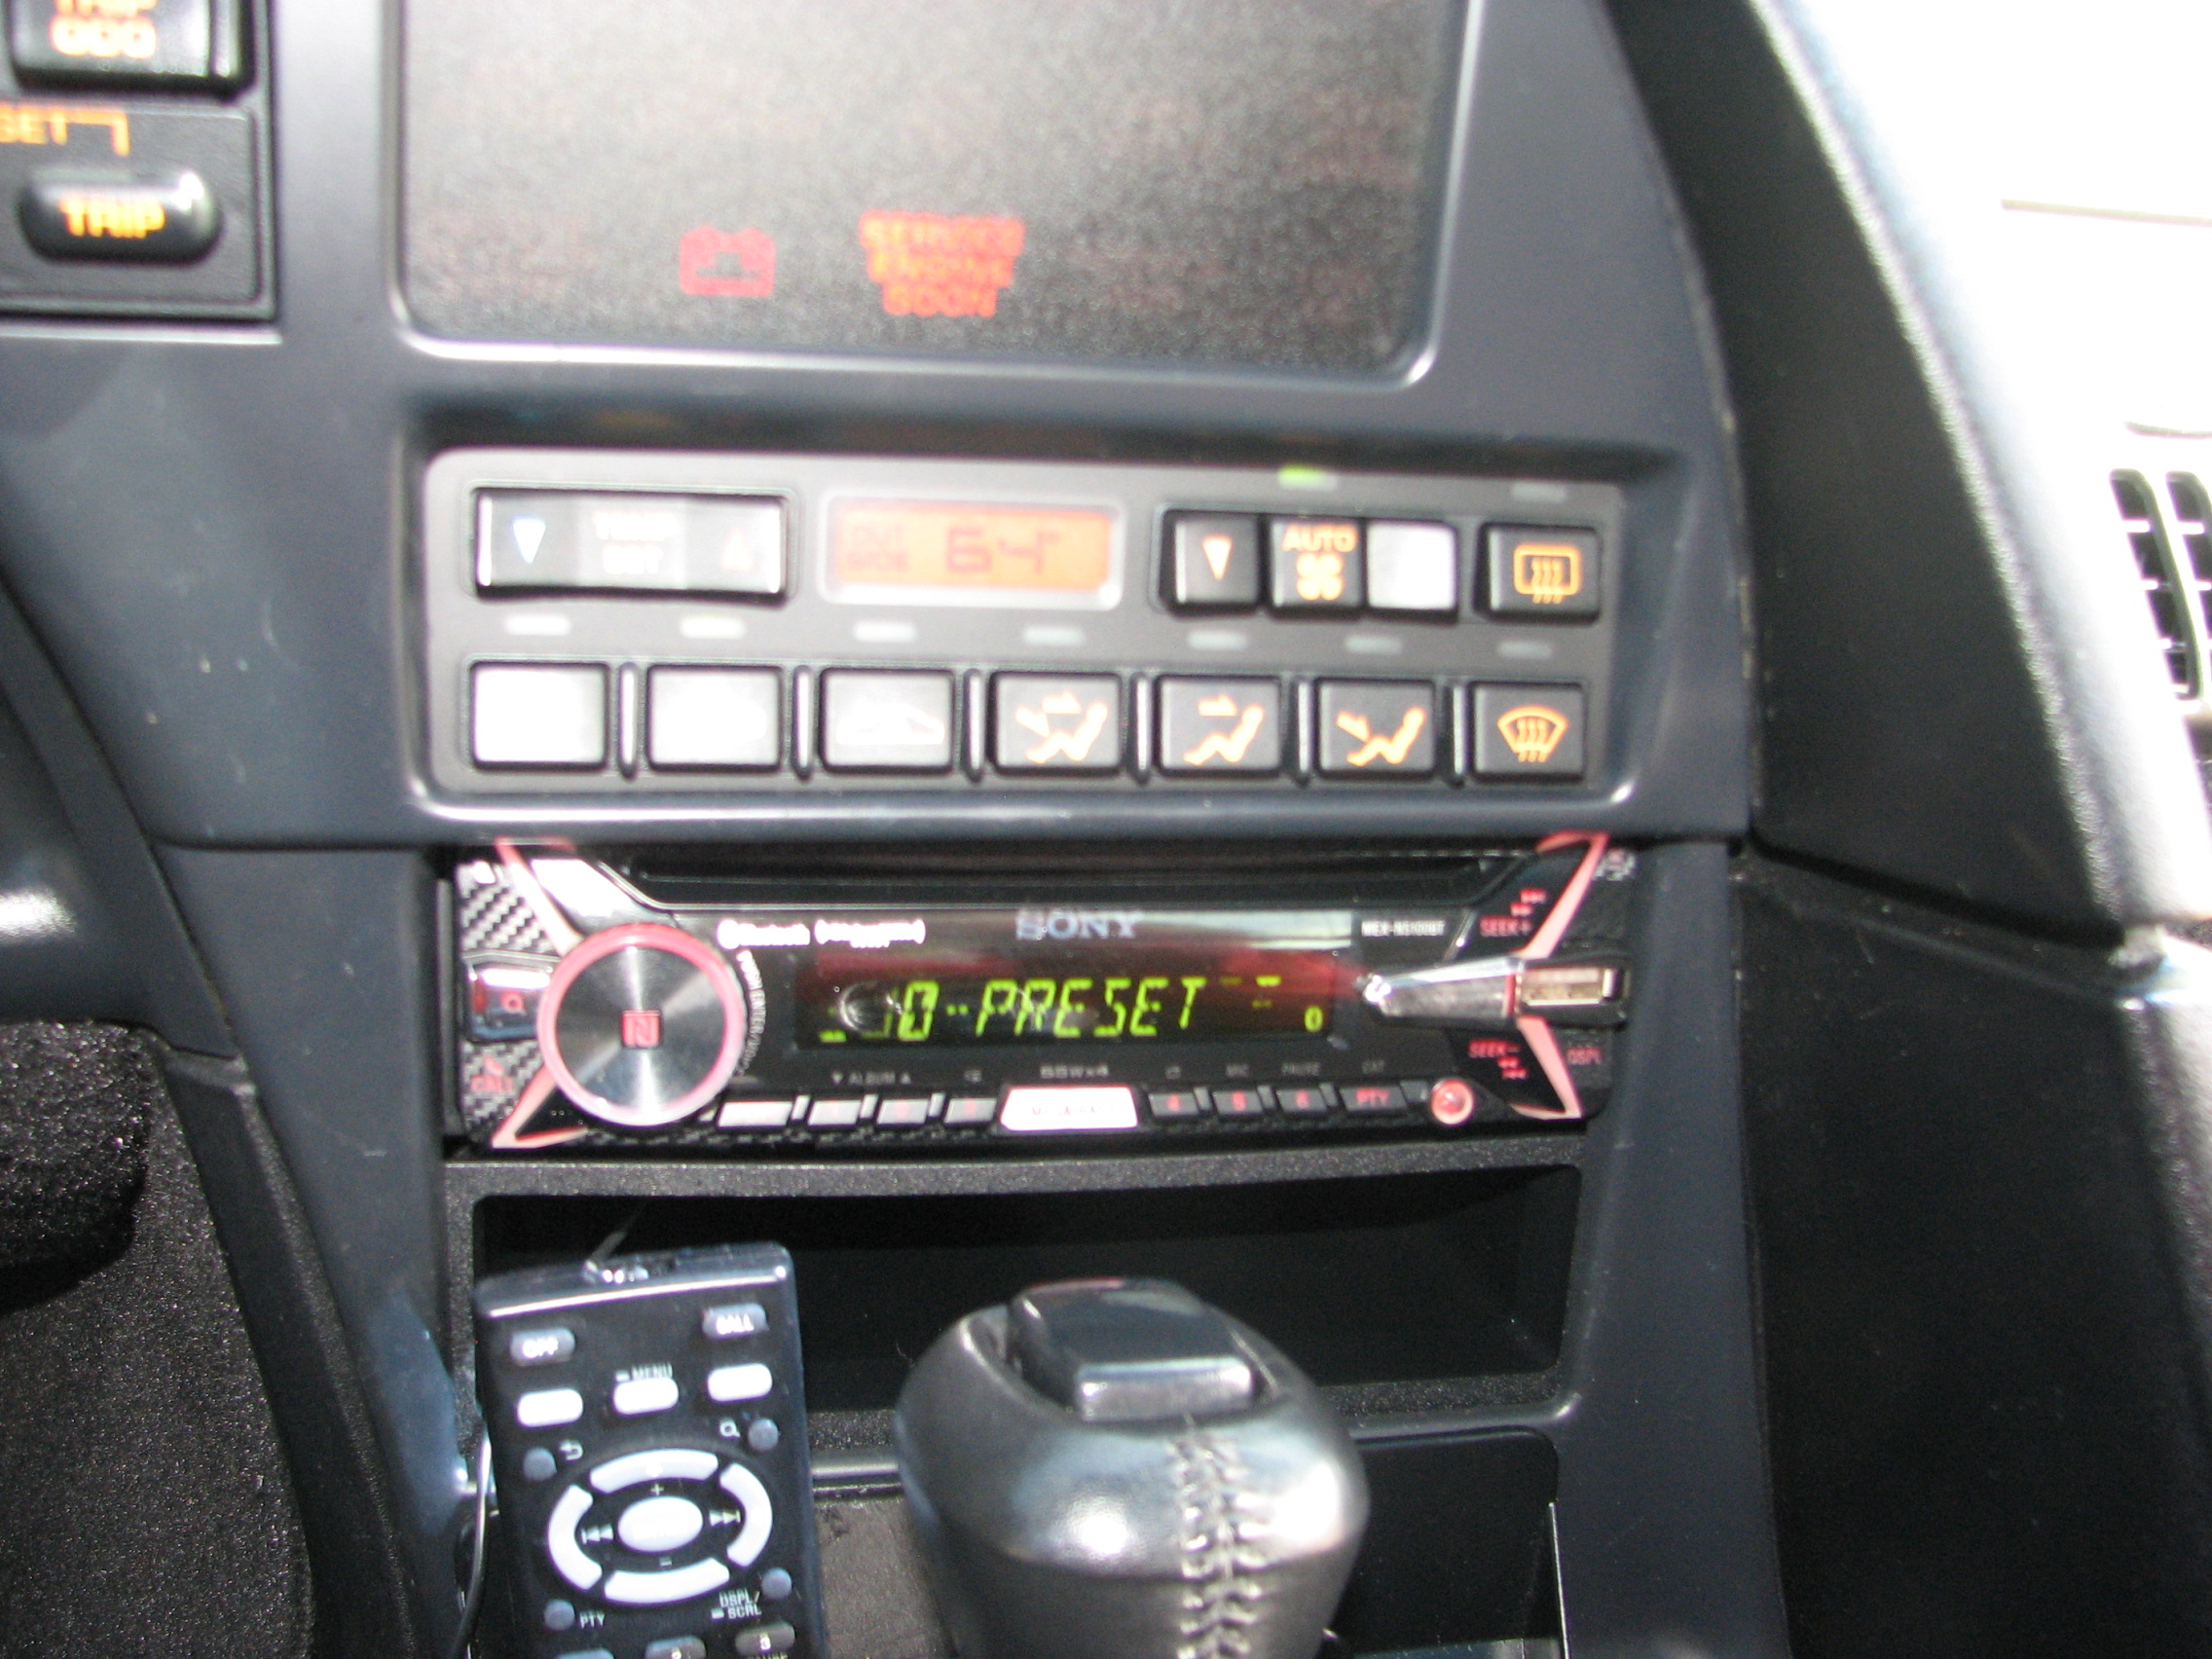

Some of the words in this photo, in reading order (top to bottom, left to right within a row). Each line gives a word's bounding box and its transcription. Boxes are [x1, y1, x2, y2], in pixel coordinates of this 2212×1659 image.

[1282, 523, 1360, 554] AUTO
[1015, 908, 1142, 941] SONY
[578, 1610, 607, 1629] PTY
